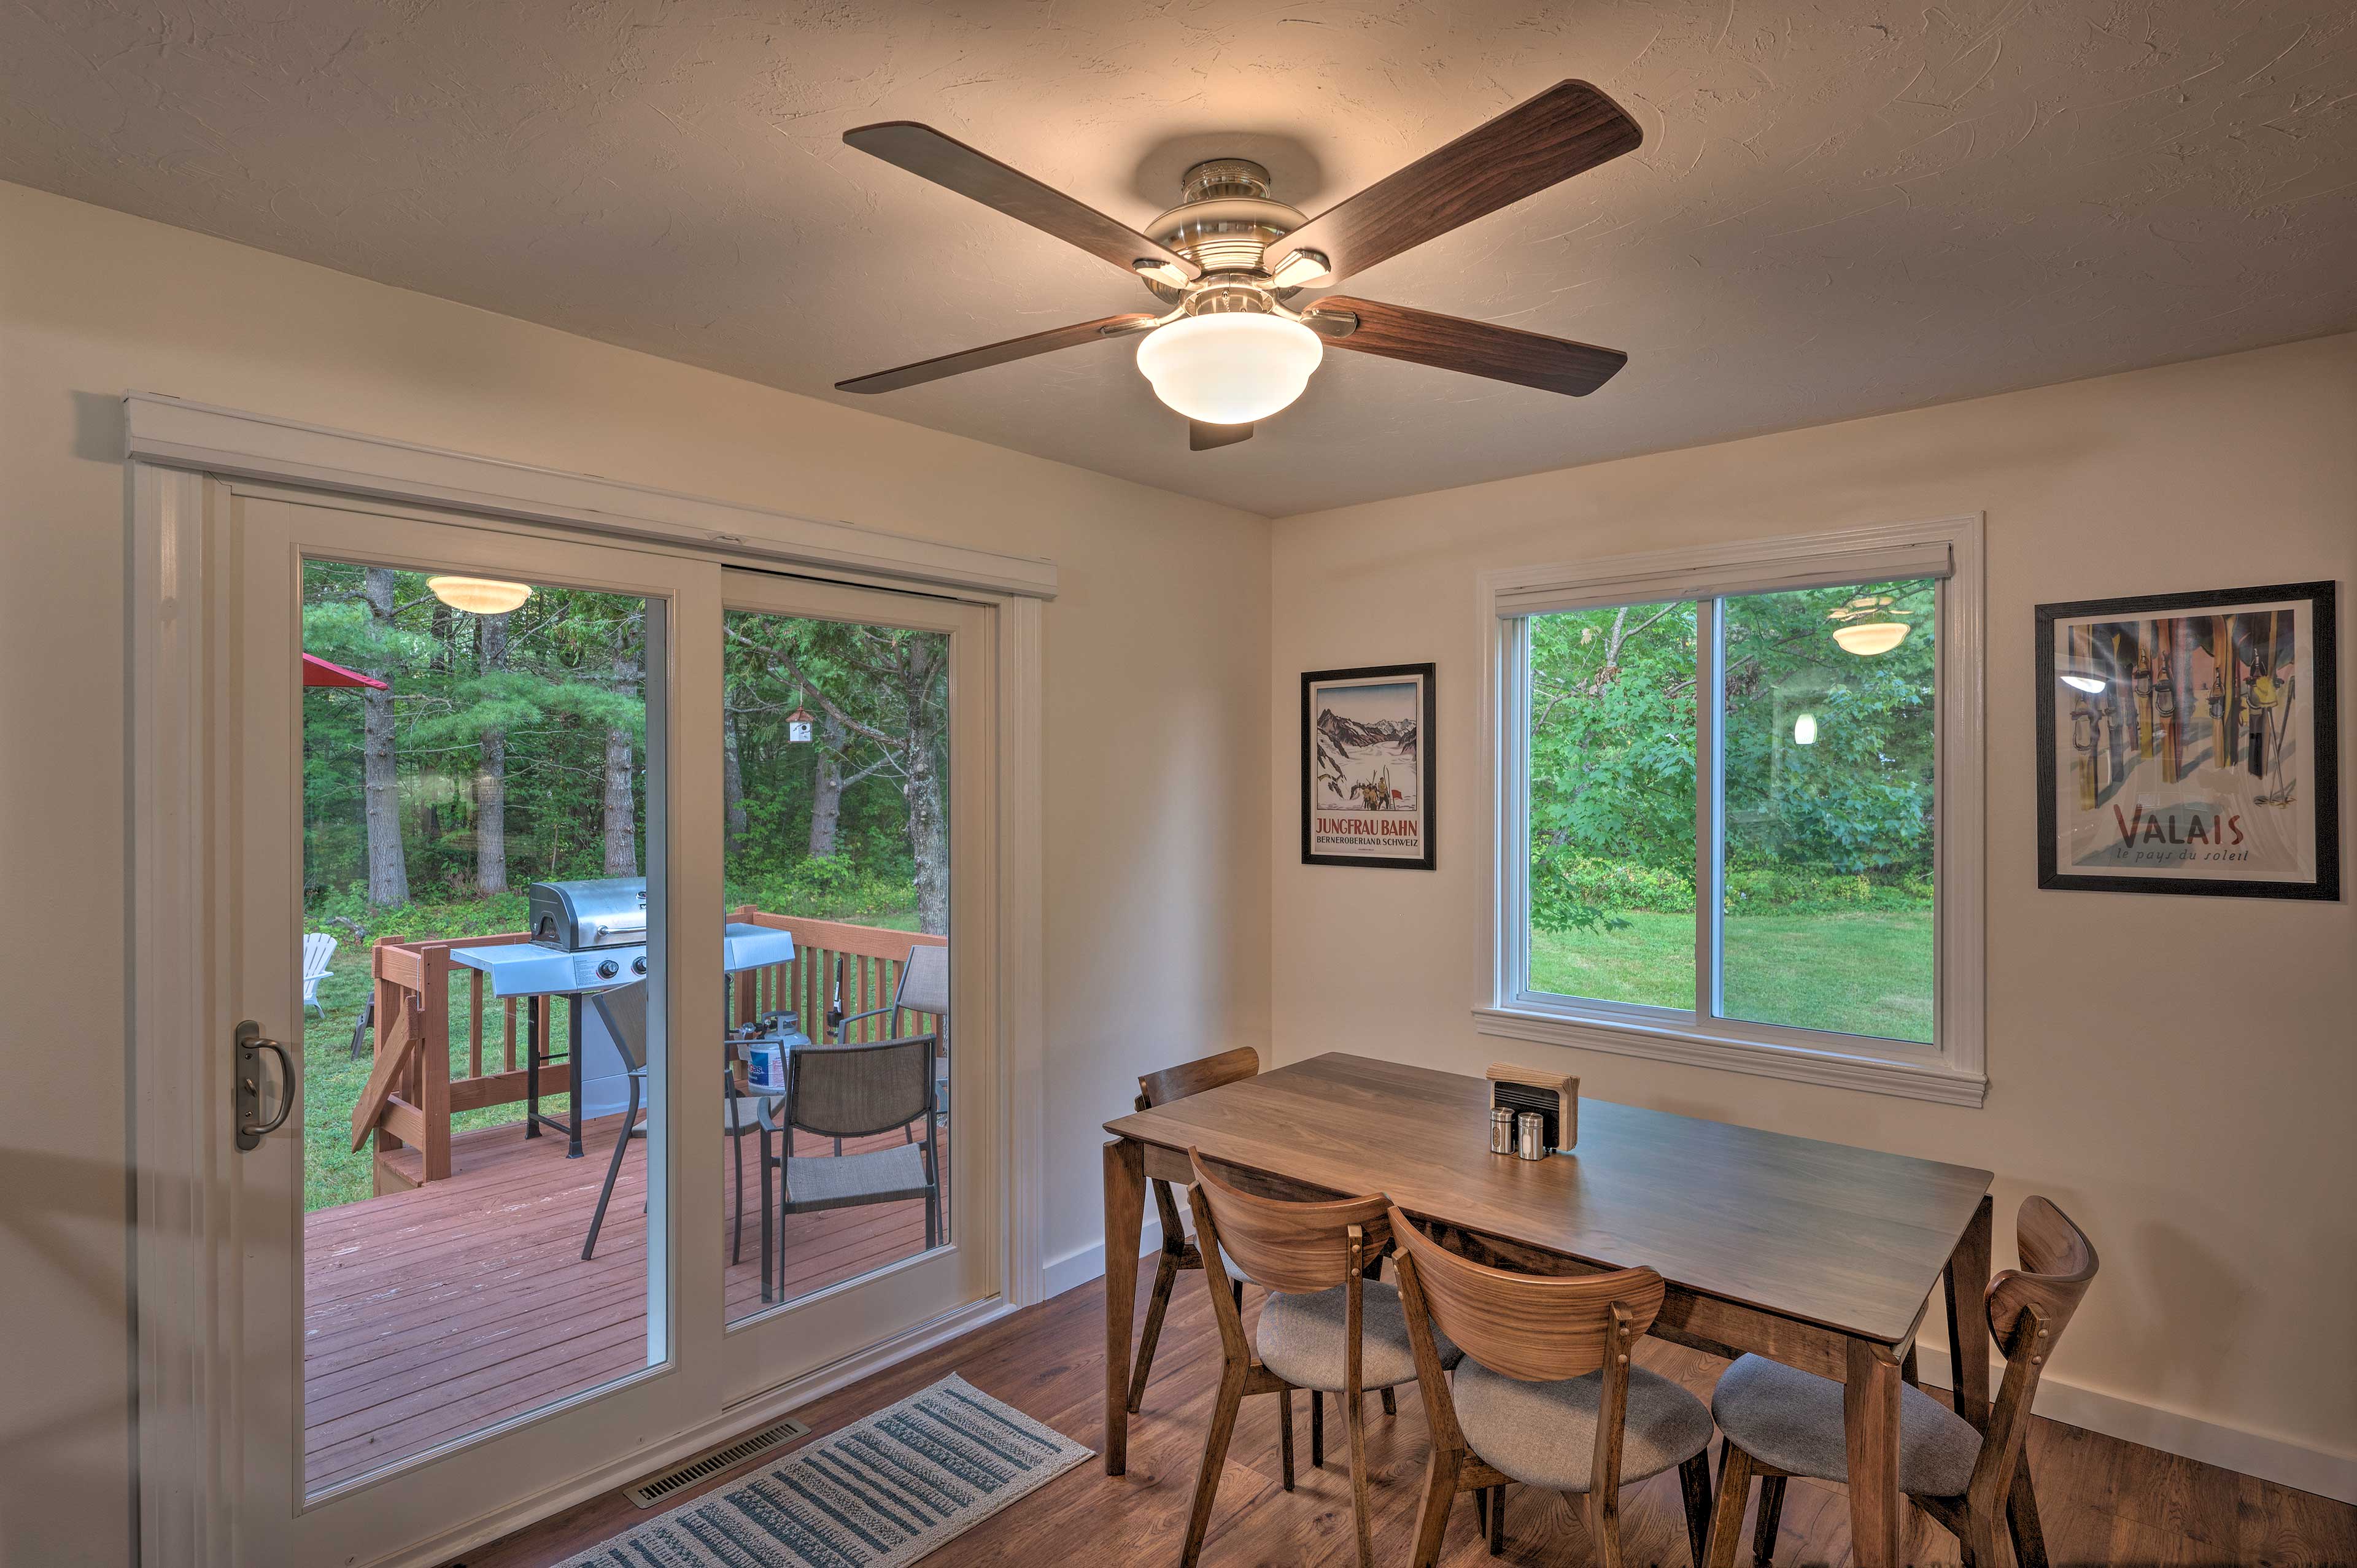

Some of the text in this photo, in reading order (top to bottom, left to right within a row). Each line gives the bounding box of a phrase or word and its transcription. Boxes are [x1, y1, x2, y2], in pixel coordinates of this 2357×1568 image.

[1316, 818, 1417, 836] JUNGFRAU BAHN
[2113, 804, 2244, 848] VALAIS
[1383, 838, 1418, 847] SCHWEIZ
[2117, 848, 2249, 863] le pays du soleil
